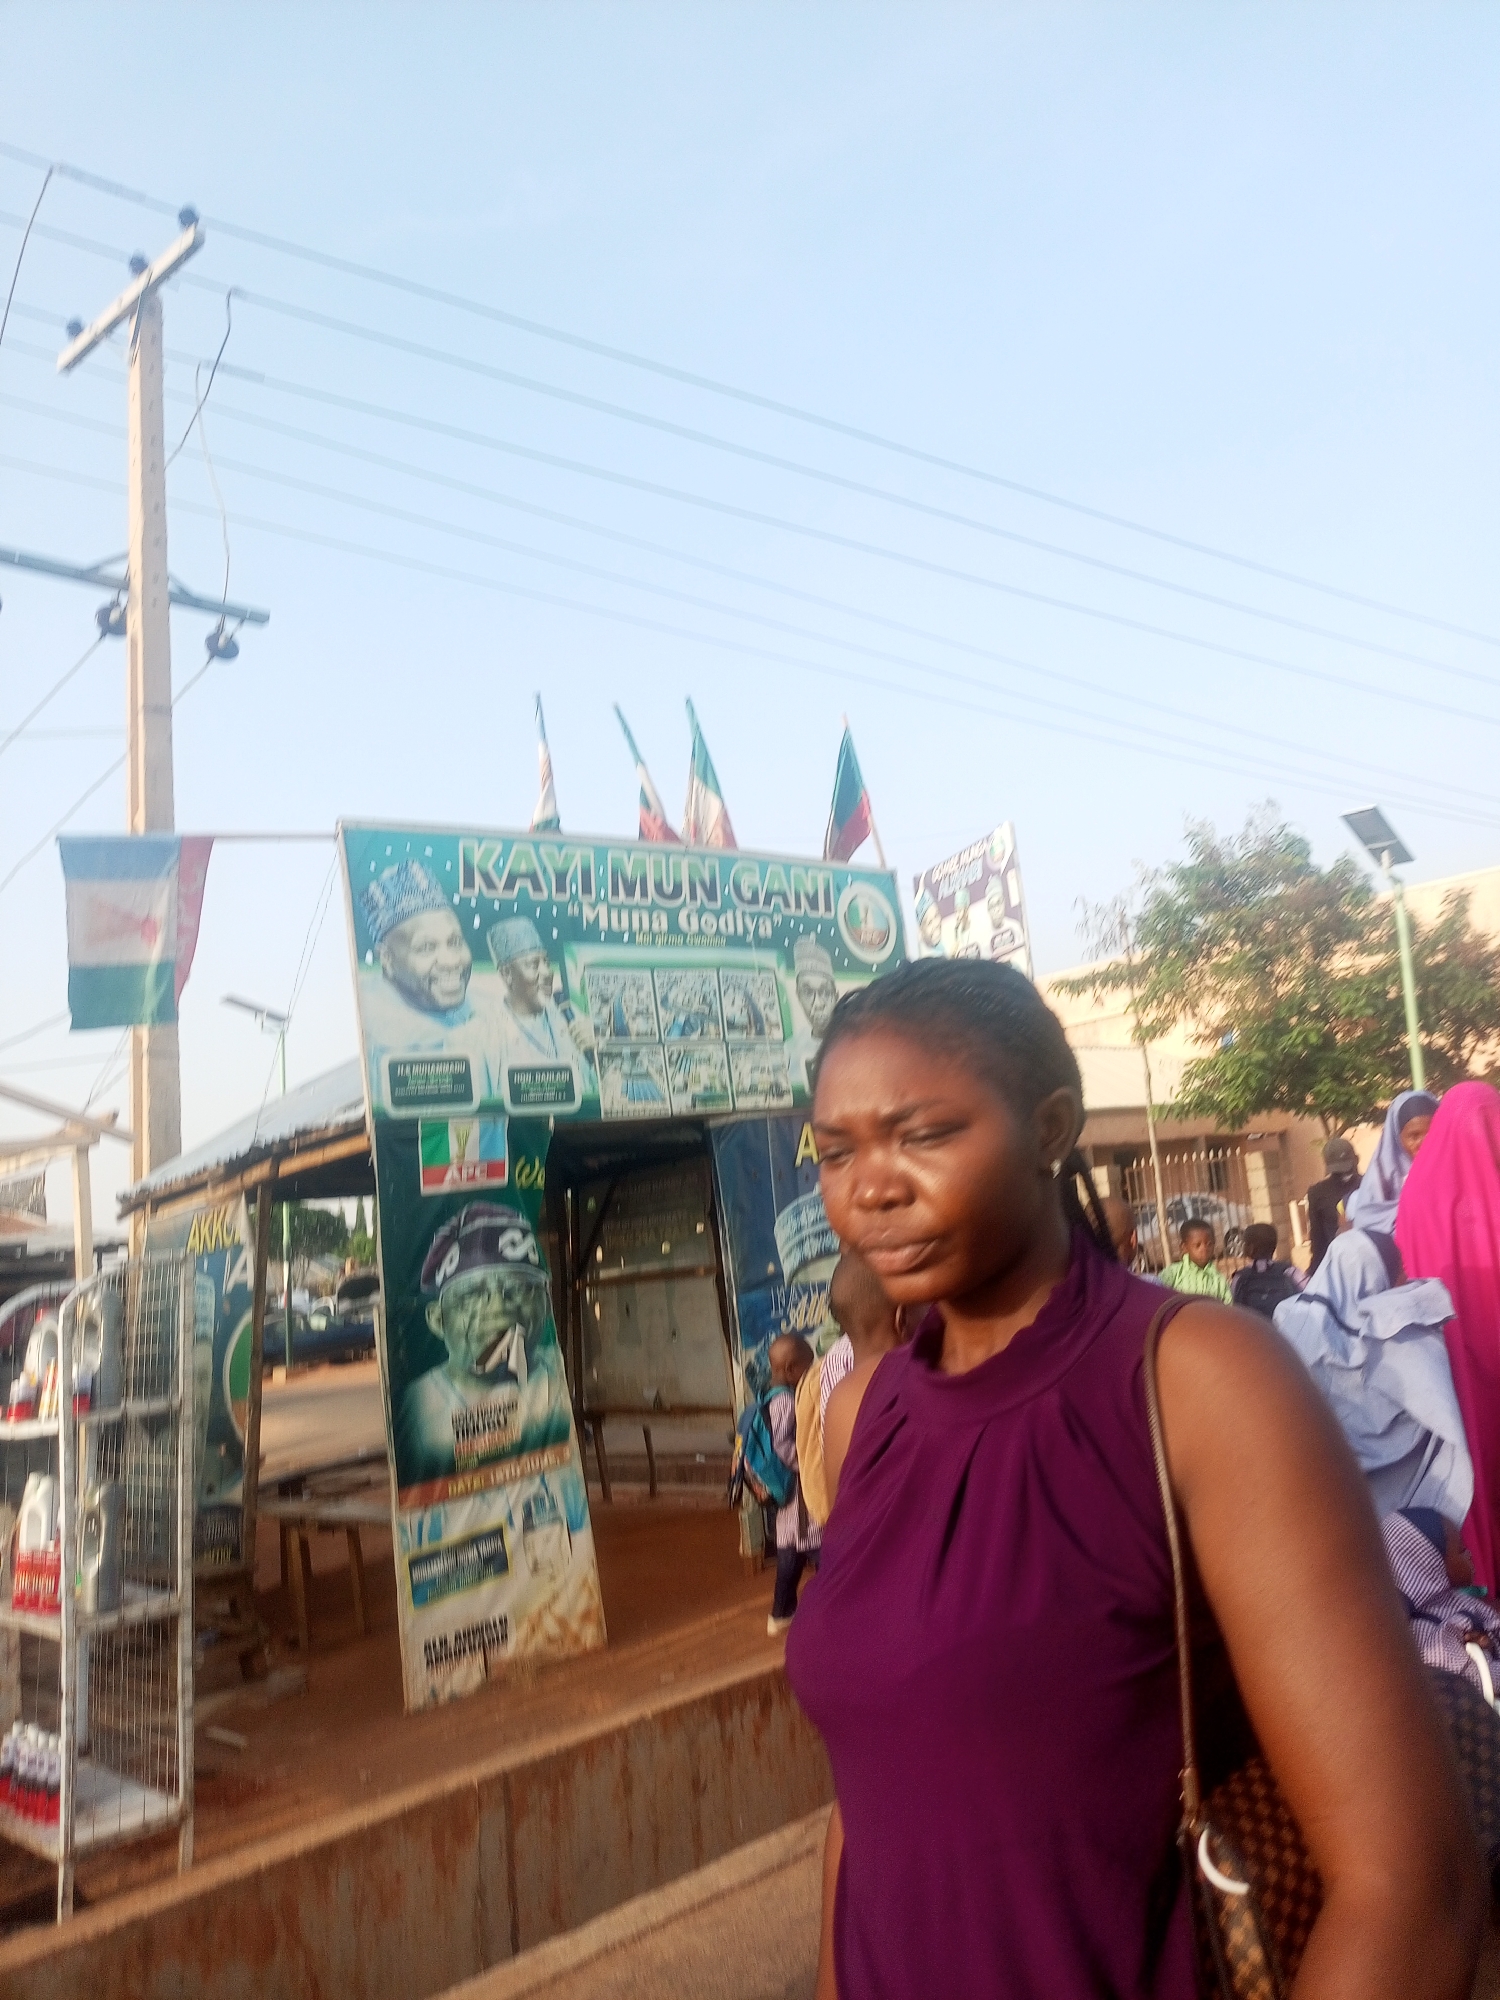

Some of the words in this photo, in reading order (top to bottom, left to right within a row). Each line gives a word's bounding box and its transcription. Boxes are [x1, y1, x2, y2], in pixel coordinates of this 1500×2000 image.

[459, 837, 596, 901] KAYI
[607, 848, 722, 910] MUN
[729, 858, 836, 920] GANI
